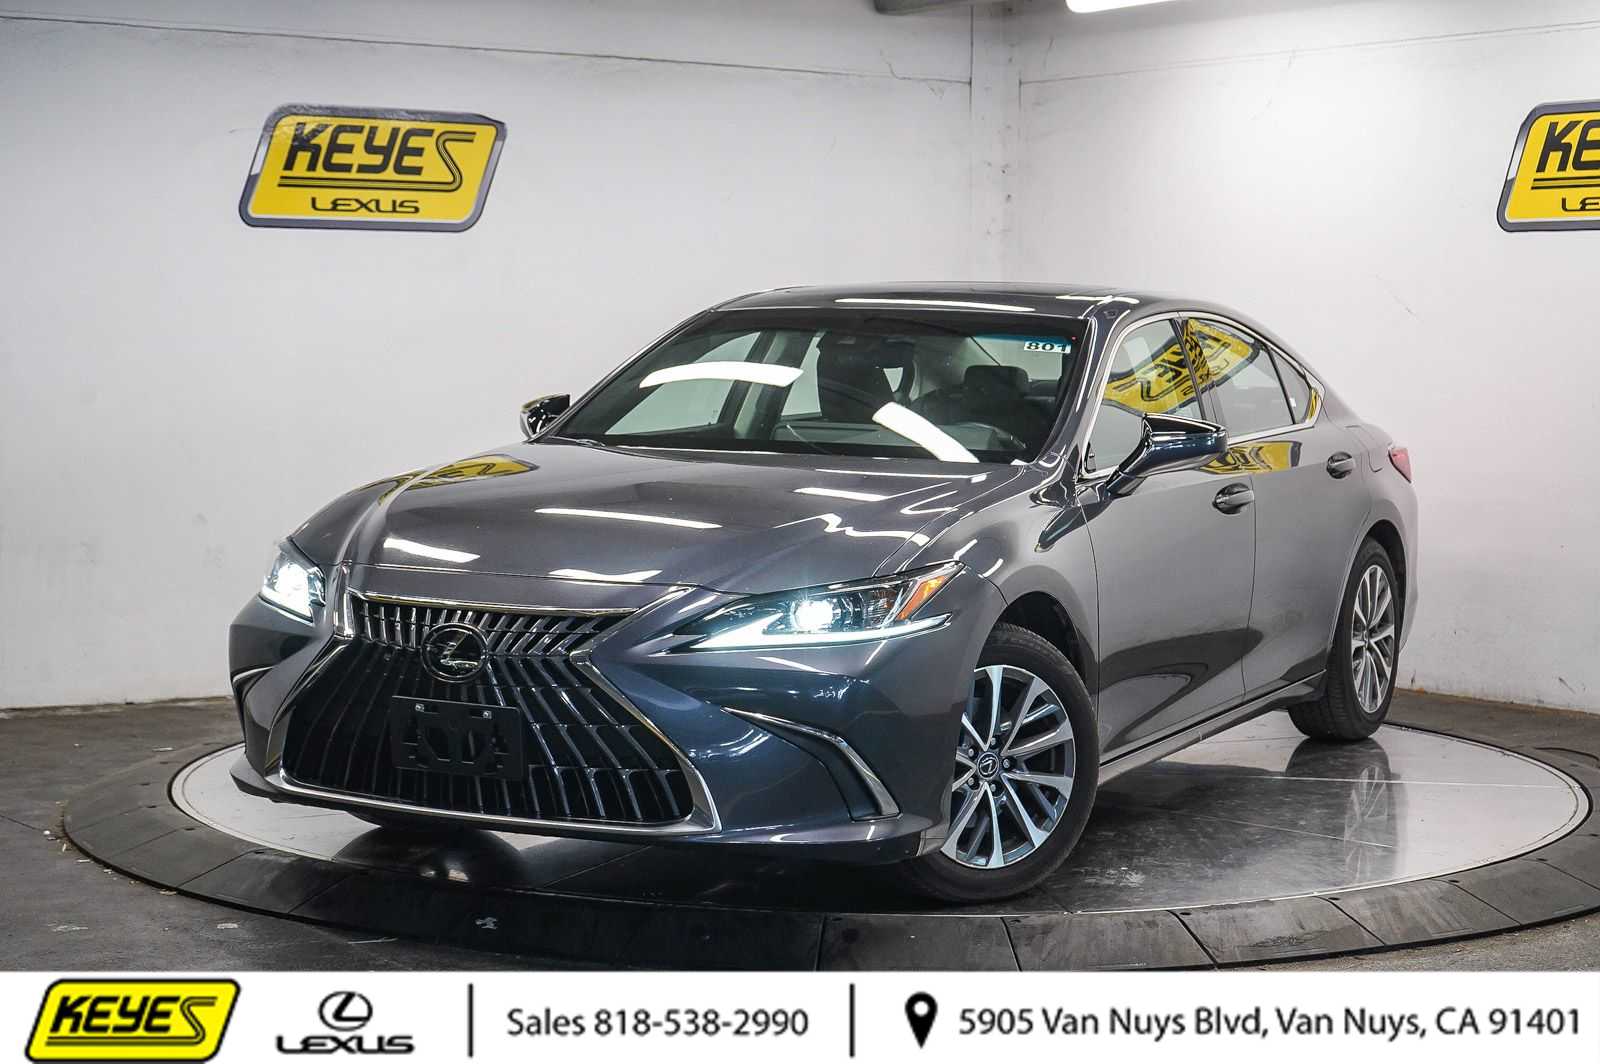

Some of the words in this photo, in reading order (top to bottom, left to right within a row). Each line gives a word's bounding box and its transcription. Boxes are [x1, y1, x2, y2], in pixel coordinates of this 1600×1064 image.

[281, 121, 477, 193] KEYES
[310, 196, 420, 214] LEXUS
[1026, 342, 1066, 352] 801
